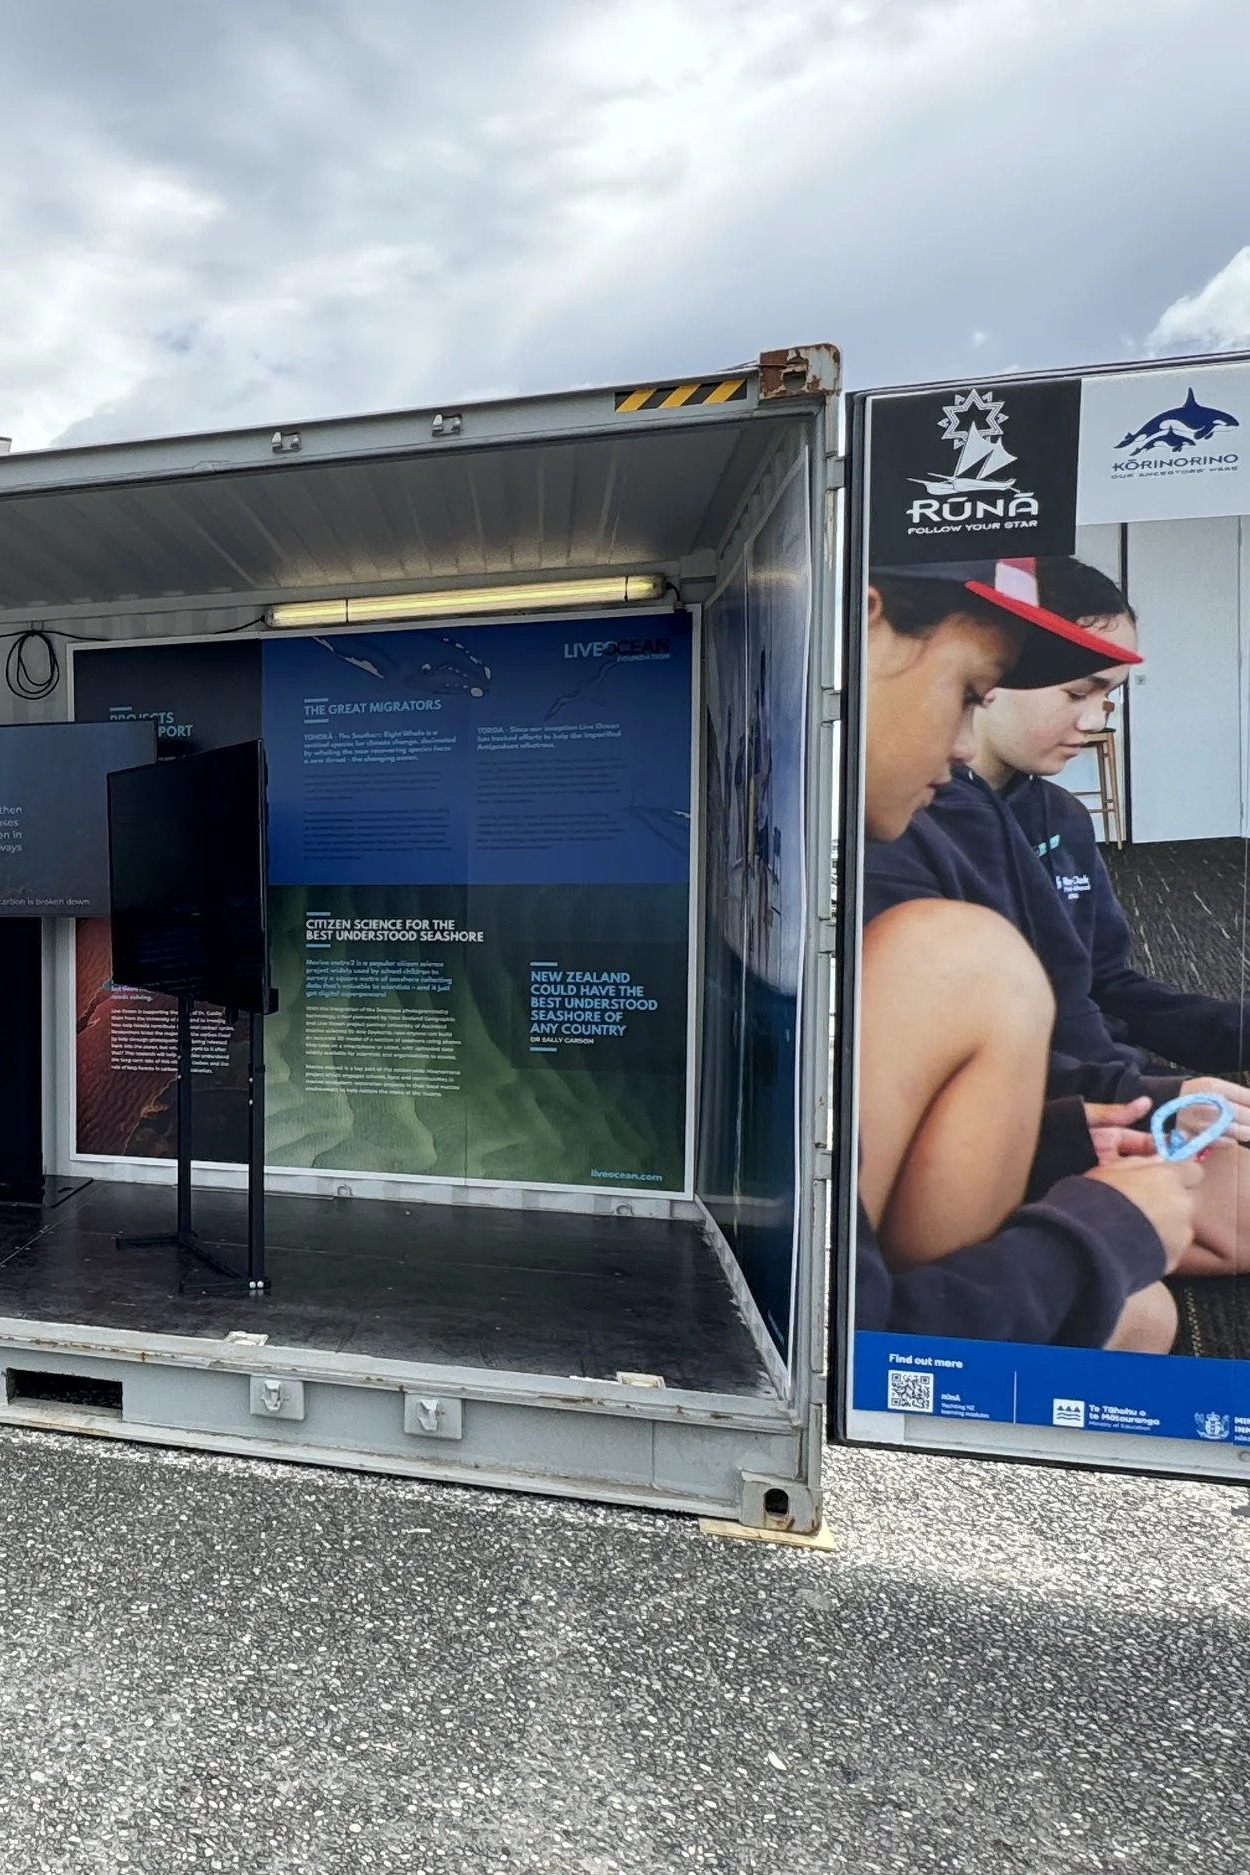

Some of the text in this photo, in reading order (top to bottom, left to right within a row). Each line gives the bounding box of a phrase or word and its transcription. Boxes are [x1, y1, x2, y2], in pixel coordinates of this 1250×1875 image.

[1112, 454, 1239, 472] KŌRINORINO
[906, 492, 1039, 523] RŪNĀ
[907, 520, 1038, 535] FOLLOW YOUR STAR
[564, 636, 670, 659] LIVEOCEAN
[617, 652, 670, 662] FOUNDATION
[304, 699, 442, 716] THE GREAT MIGRATORS
[158, 725, 193, 738] PORT
[0, 805, 22, 815] then
[12, 830, 22, 839] in
[27, 898, 34, 906] is
[35, 898, 64, 906] broken
[66, 898, 90, 906] down
[305, 919, 455, 930] CITIZEN SCIENCE FOR THE
[306, 930, 485, 942] BEST UNDERSTOOD SEASHORE
[530, 971, 630, 983] NEW ZEALAND
[530, 984, 644, 997] COULD HAVE THE
[530, 997, 658, 1011] BEST UNDERSTOOD
[530, 1010, 624, 1022] SEASHORE OF
[530, 1022, 627, 1037] ANY COUNTRY
[564, 1037, 595, 1045] CARSON
[590, 1168, 663, 1182] liveocean.com
[889, 1353, 964, 1369] Find out more
[1089, 1404, 1147, 1417] Te Tāhuhu o
[1089, 1412, 1161, 1426] te Mātauranga
[1089, 1420, 1112, 1428] Ministry
[1120, 1423, 1151, 1431] Education
